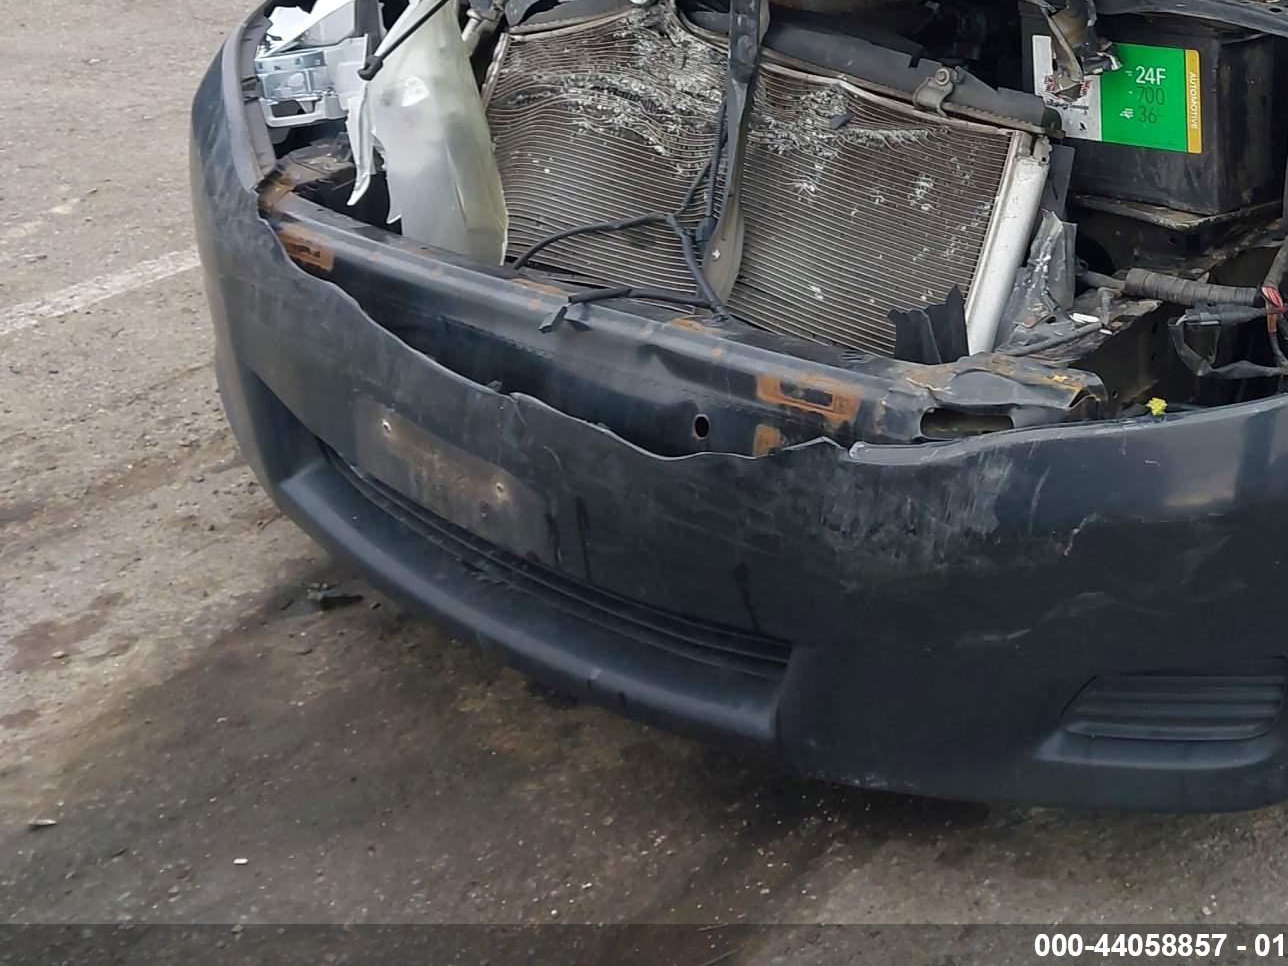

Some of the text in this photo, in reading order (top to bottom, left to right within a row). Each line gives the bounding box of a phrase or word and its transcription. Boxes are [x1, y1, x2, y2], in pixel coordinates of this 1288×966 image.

[1135, 66, 1167, 85] 24F
[1136, 85, 1165, 106] 700
[1188, 71, 1199, 130] AUTOMOTIVE
